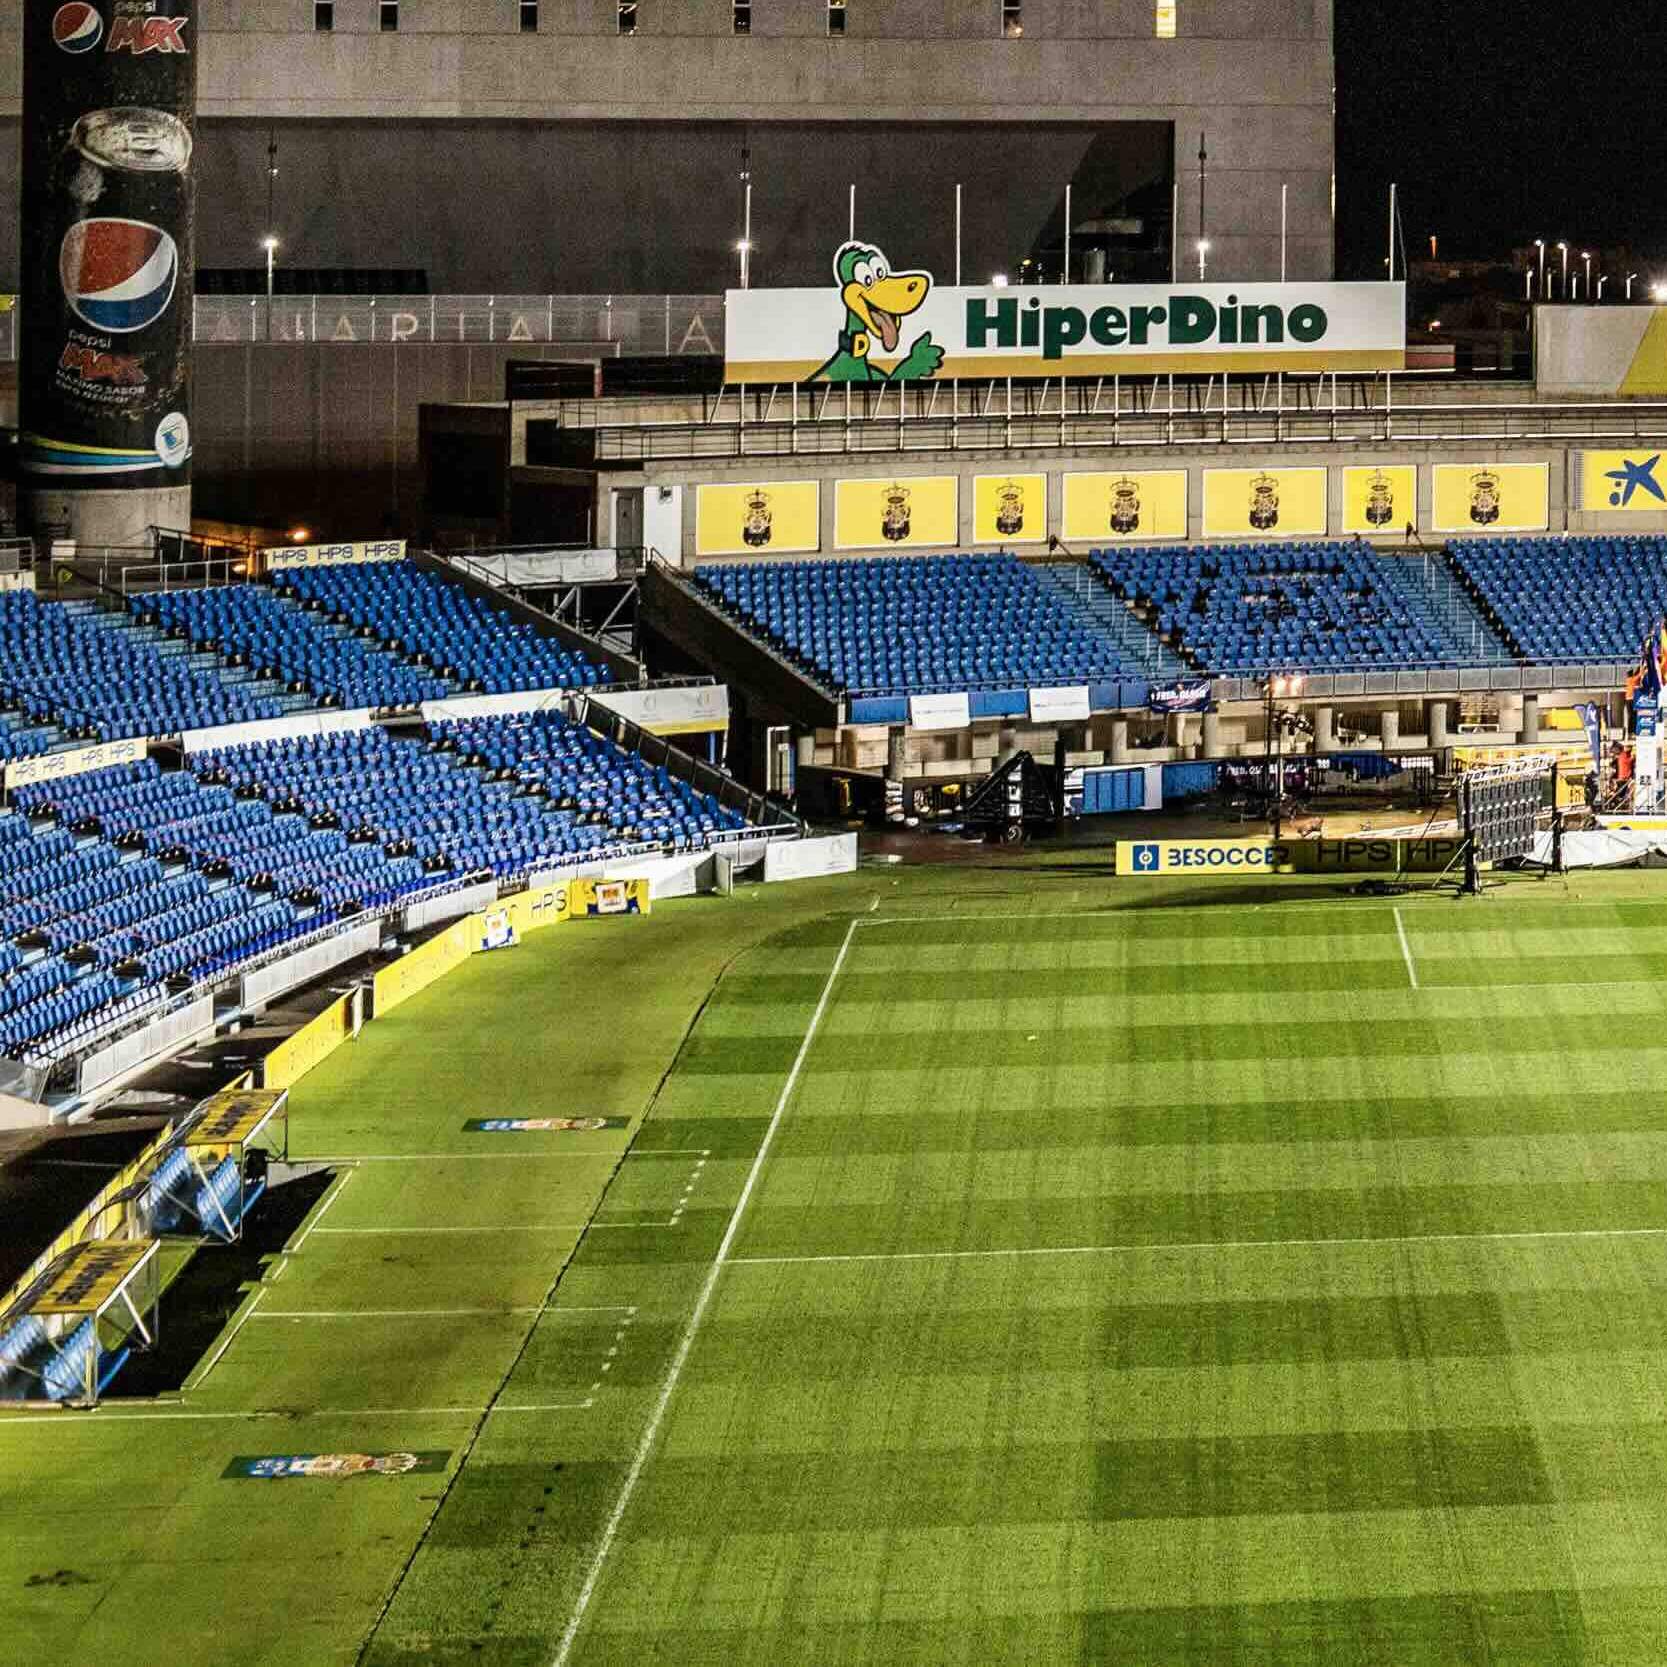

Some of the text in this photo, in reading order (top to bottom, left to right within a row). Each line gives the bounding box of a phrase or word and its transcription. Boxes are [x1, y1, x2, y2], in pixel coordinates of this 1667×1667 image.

[967, 295, 1328, 360] HiperDino
[273, 540, 400, 563] HPS HPS HPS
[1318, 842, 1390, 862] HPS
